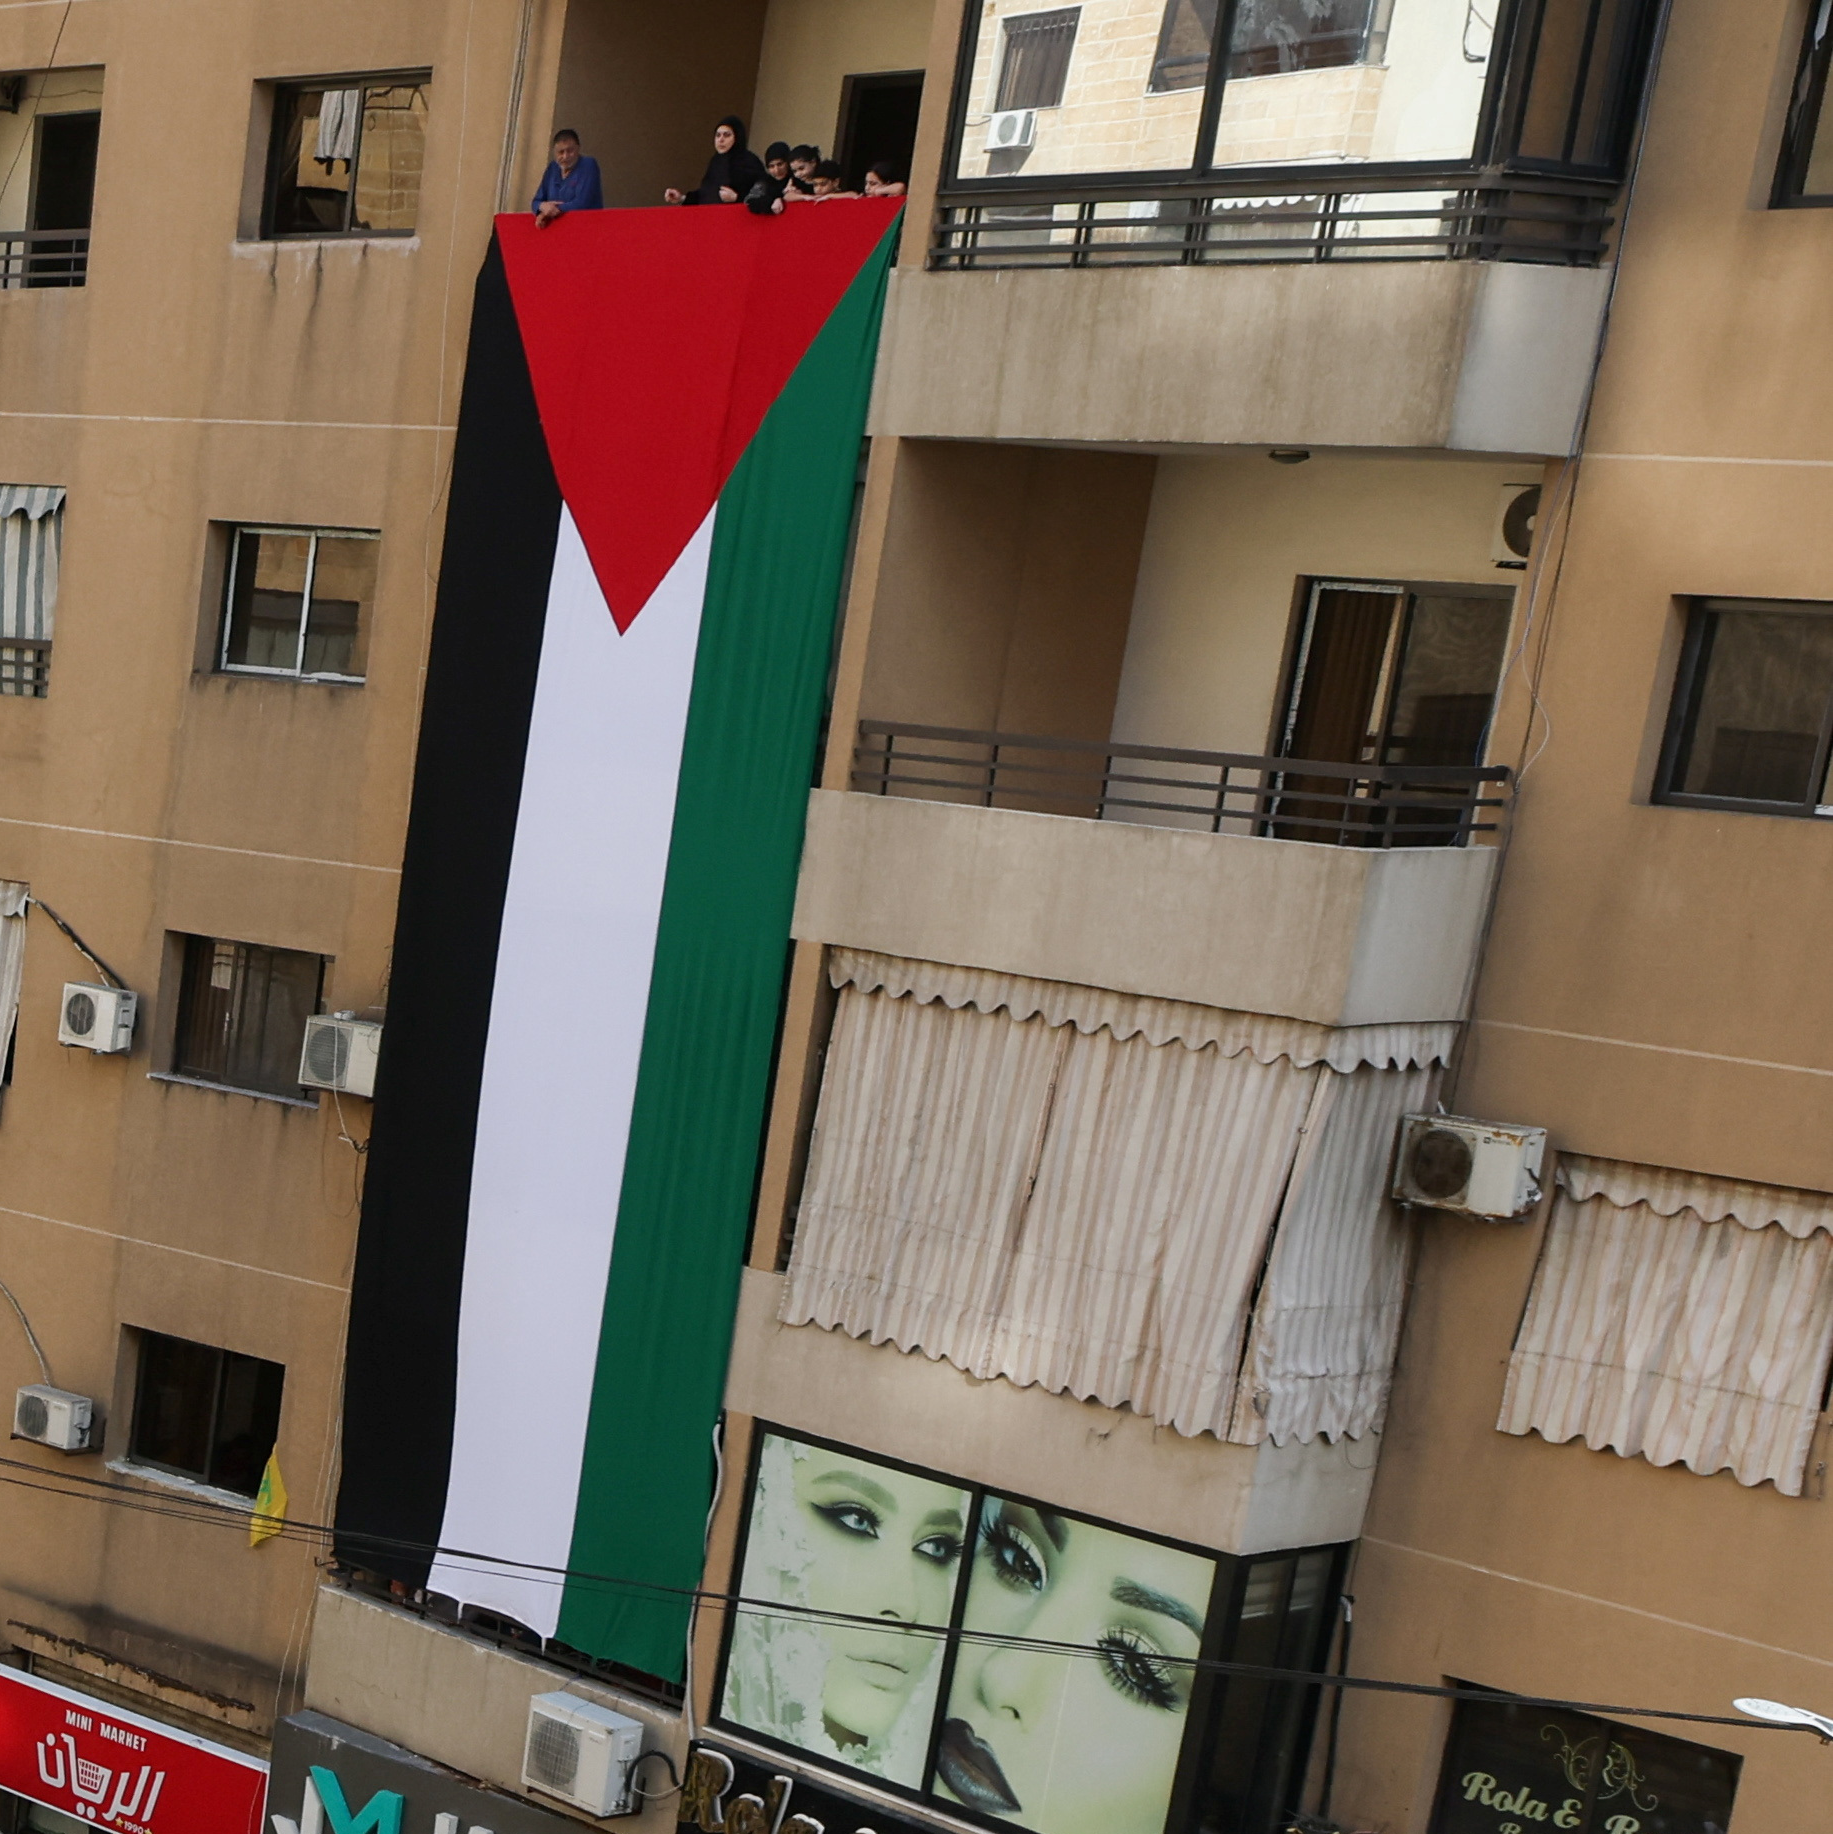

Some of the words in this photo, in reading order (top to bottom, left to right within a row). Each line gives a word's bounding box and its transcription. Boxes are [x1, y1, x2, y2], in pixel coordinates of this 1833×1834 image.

[65, 1709, 93, 1732] MINI
[36, 1733, 166, 1823] الريان
[1461, 1771, 1549, 1822] Rola
[1553, 1798, 1582, 1829] &
